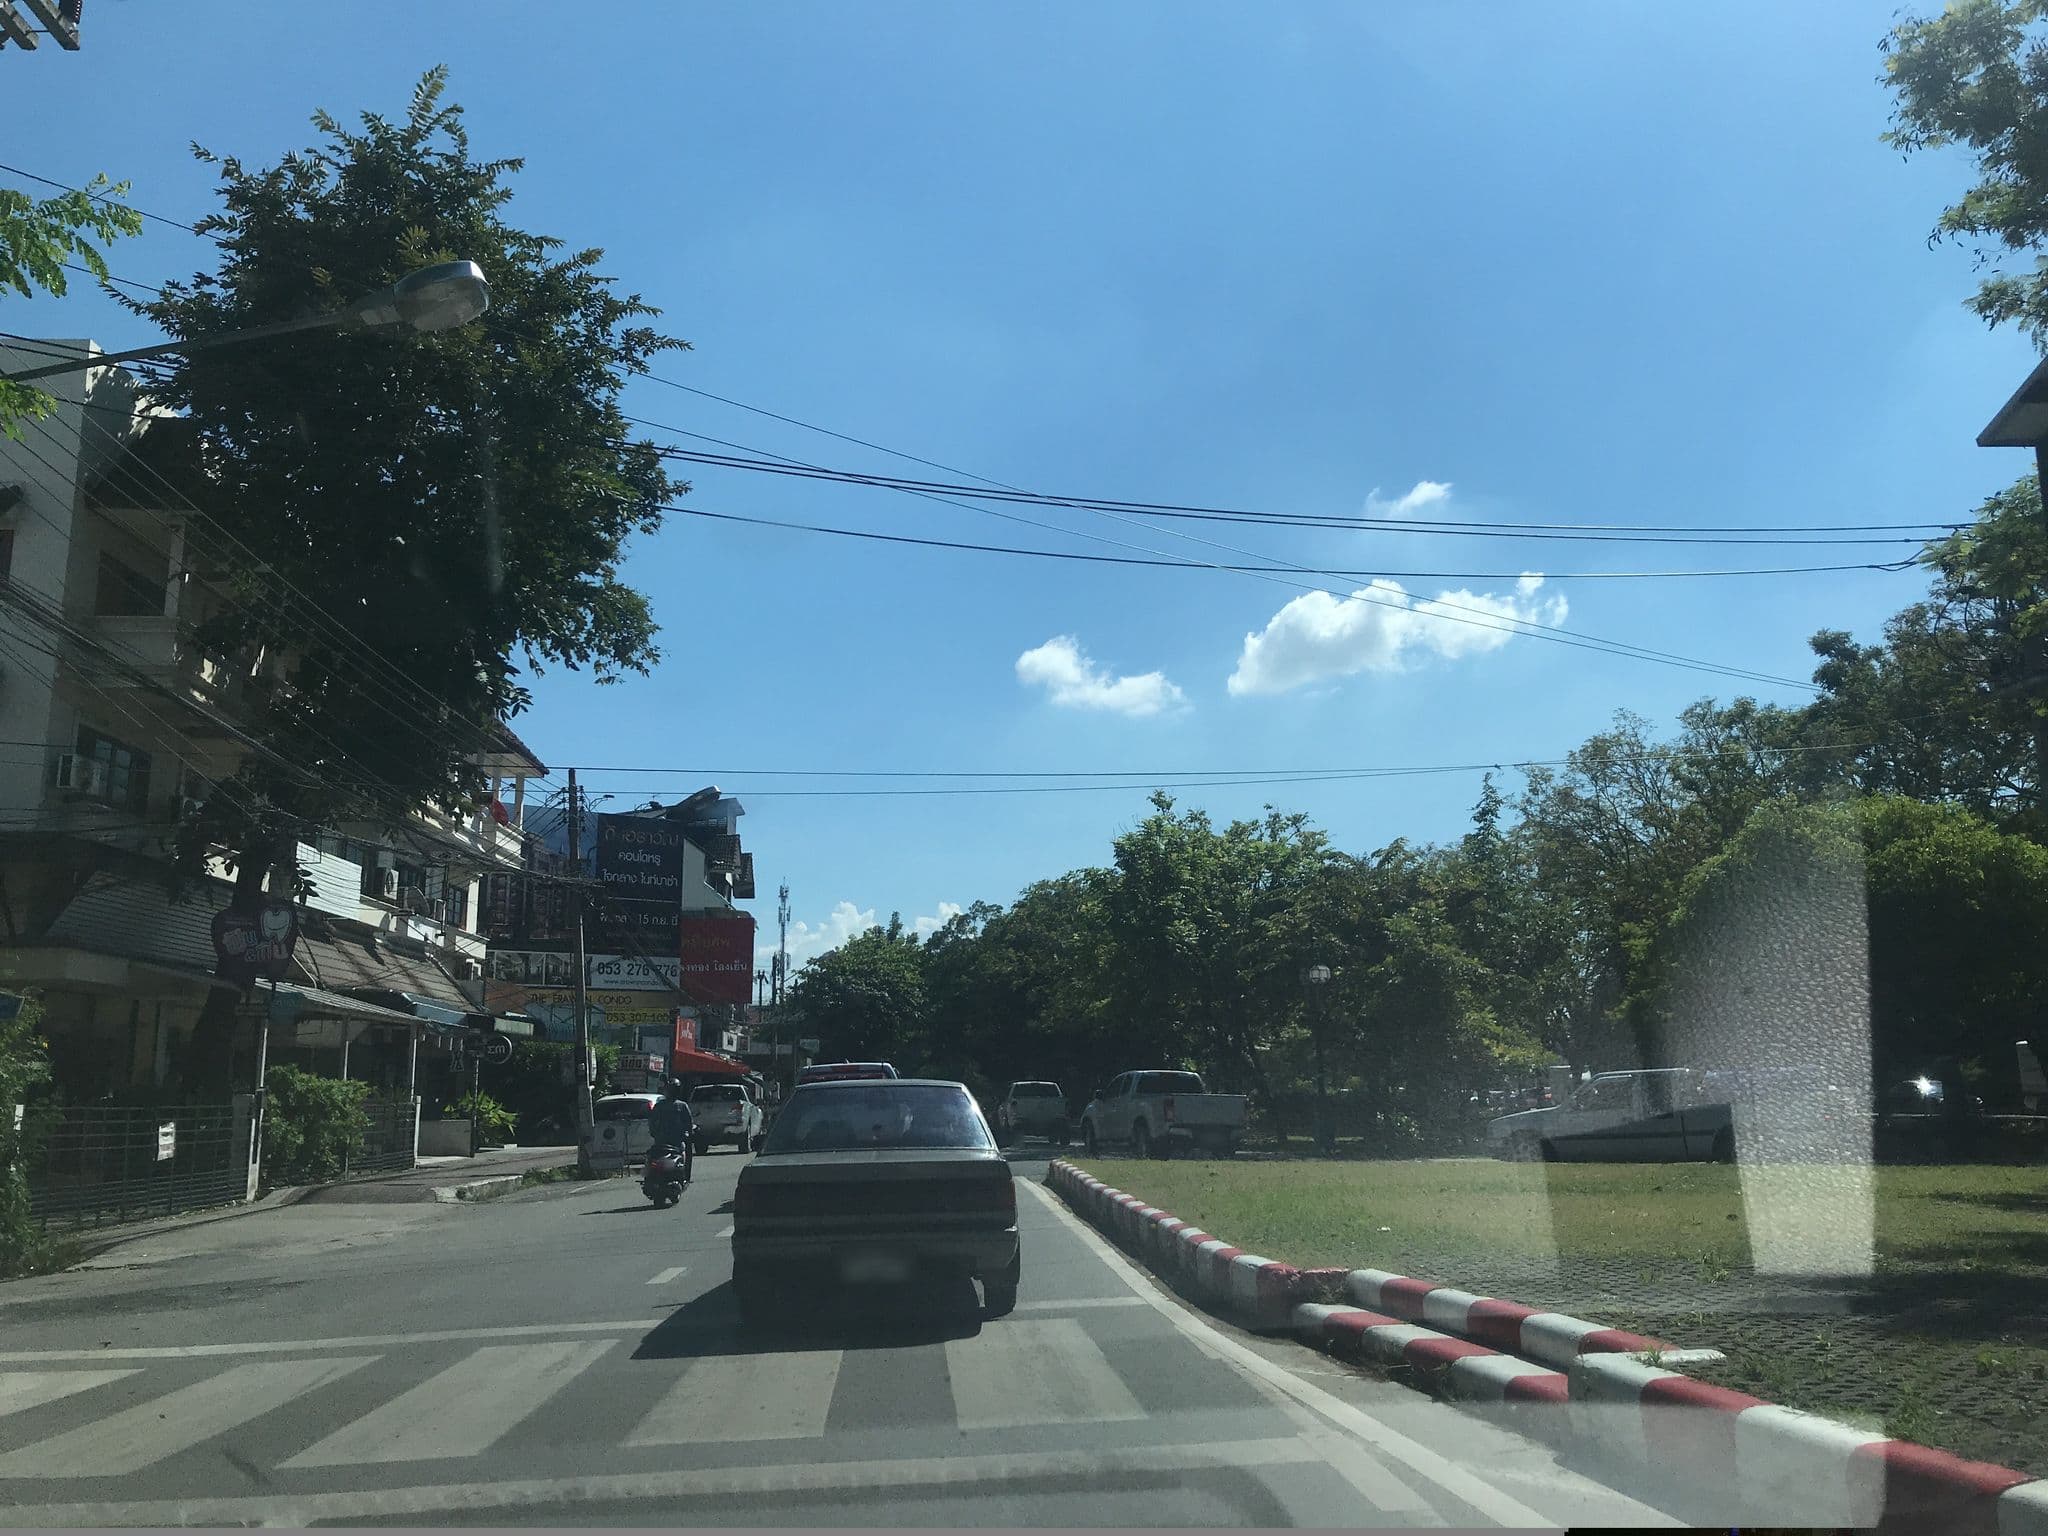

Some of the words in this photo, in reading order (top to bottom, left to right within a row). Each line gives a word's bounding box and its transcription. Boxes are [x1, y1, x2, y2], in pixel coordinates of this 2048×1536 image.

[618, 849, 661, 866] คอนโดหรู
[638, 913, 649, 925] 15
[597, 961, 621, 975] 053
[552, 993, 592, 1003] ERAWN
[598, 994, 632, 1005] CONDO
